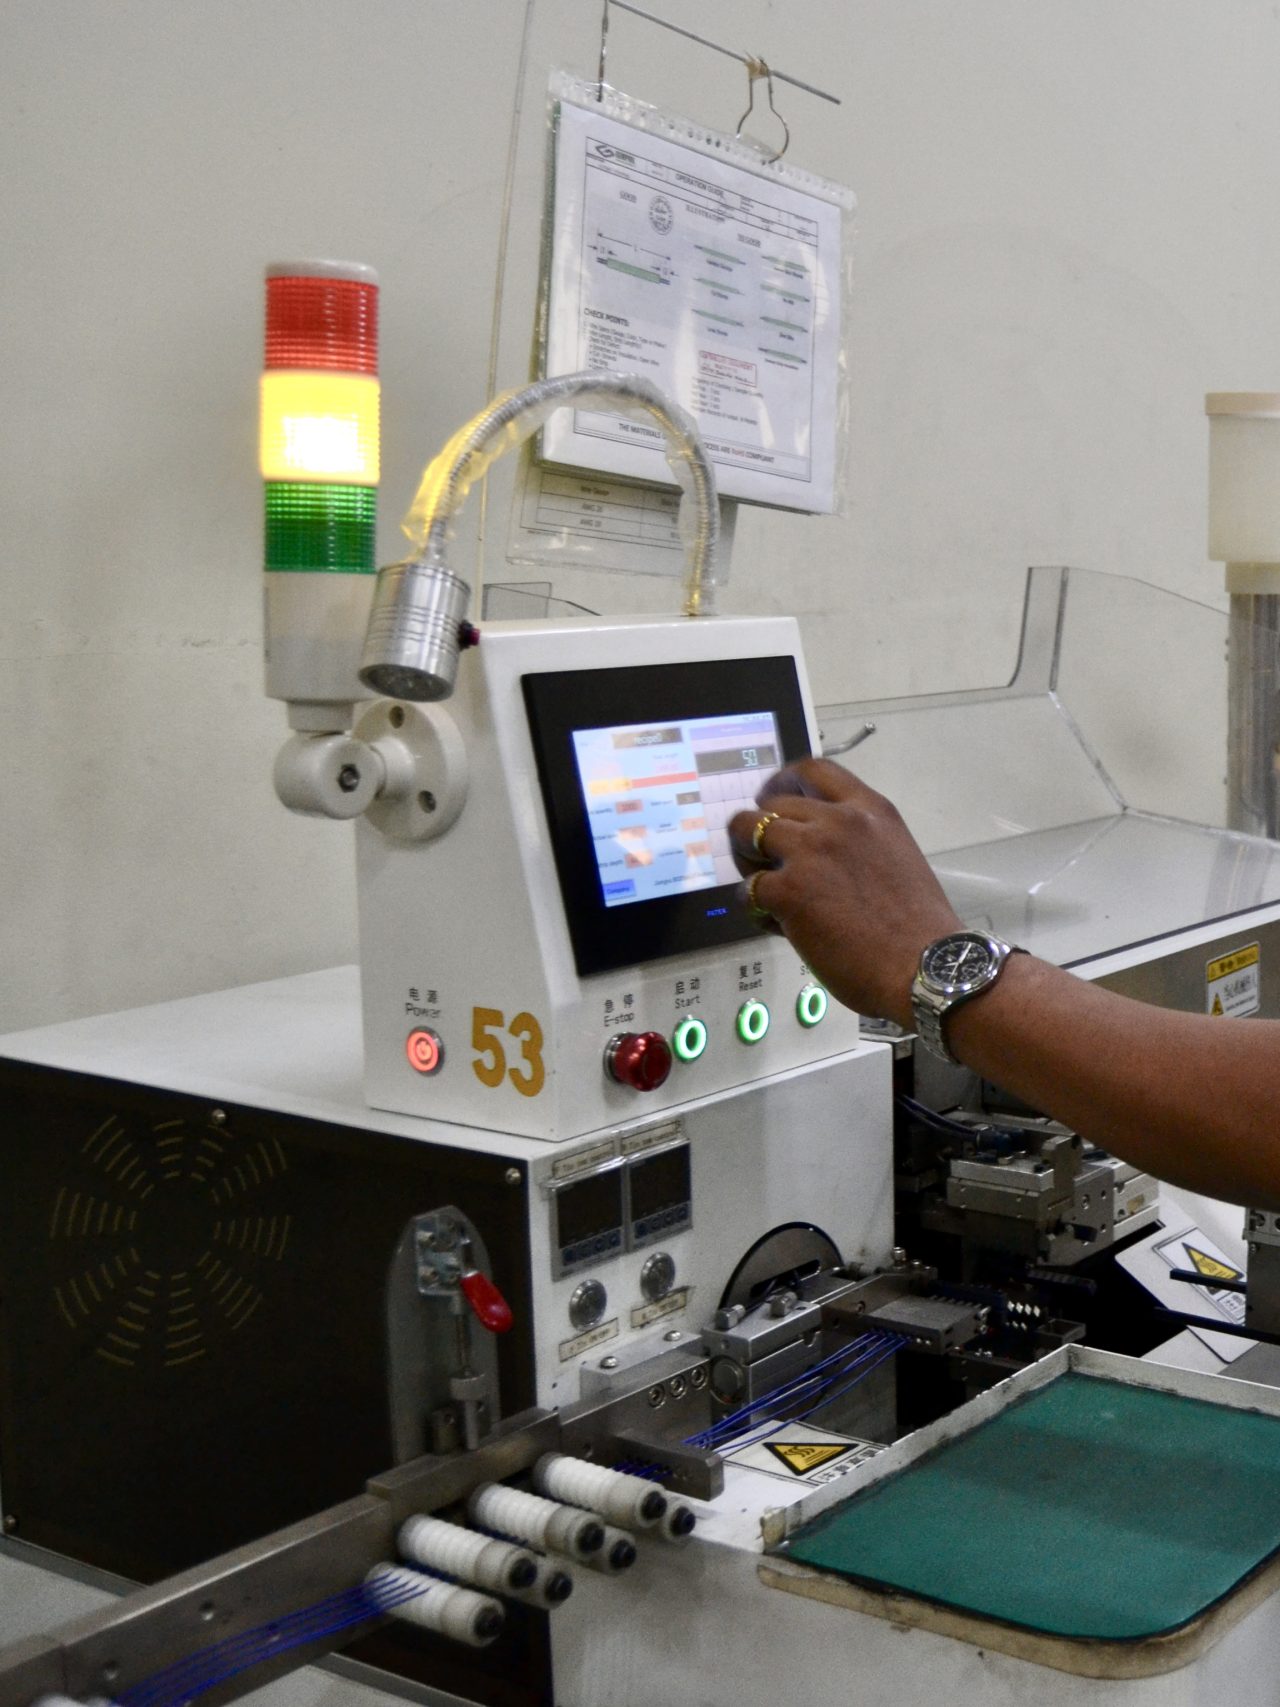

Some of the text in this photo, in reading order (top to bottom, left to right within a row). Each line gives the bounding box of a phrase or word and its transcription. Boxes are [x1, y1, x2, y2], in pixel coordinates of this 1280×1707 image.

[405, 1002, 441, 1019] Power
[675, 995, 702, 1009] Start
[472, 1006, 545, 1097] 53
